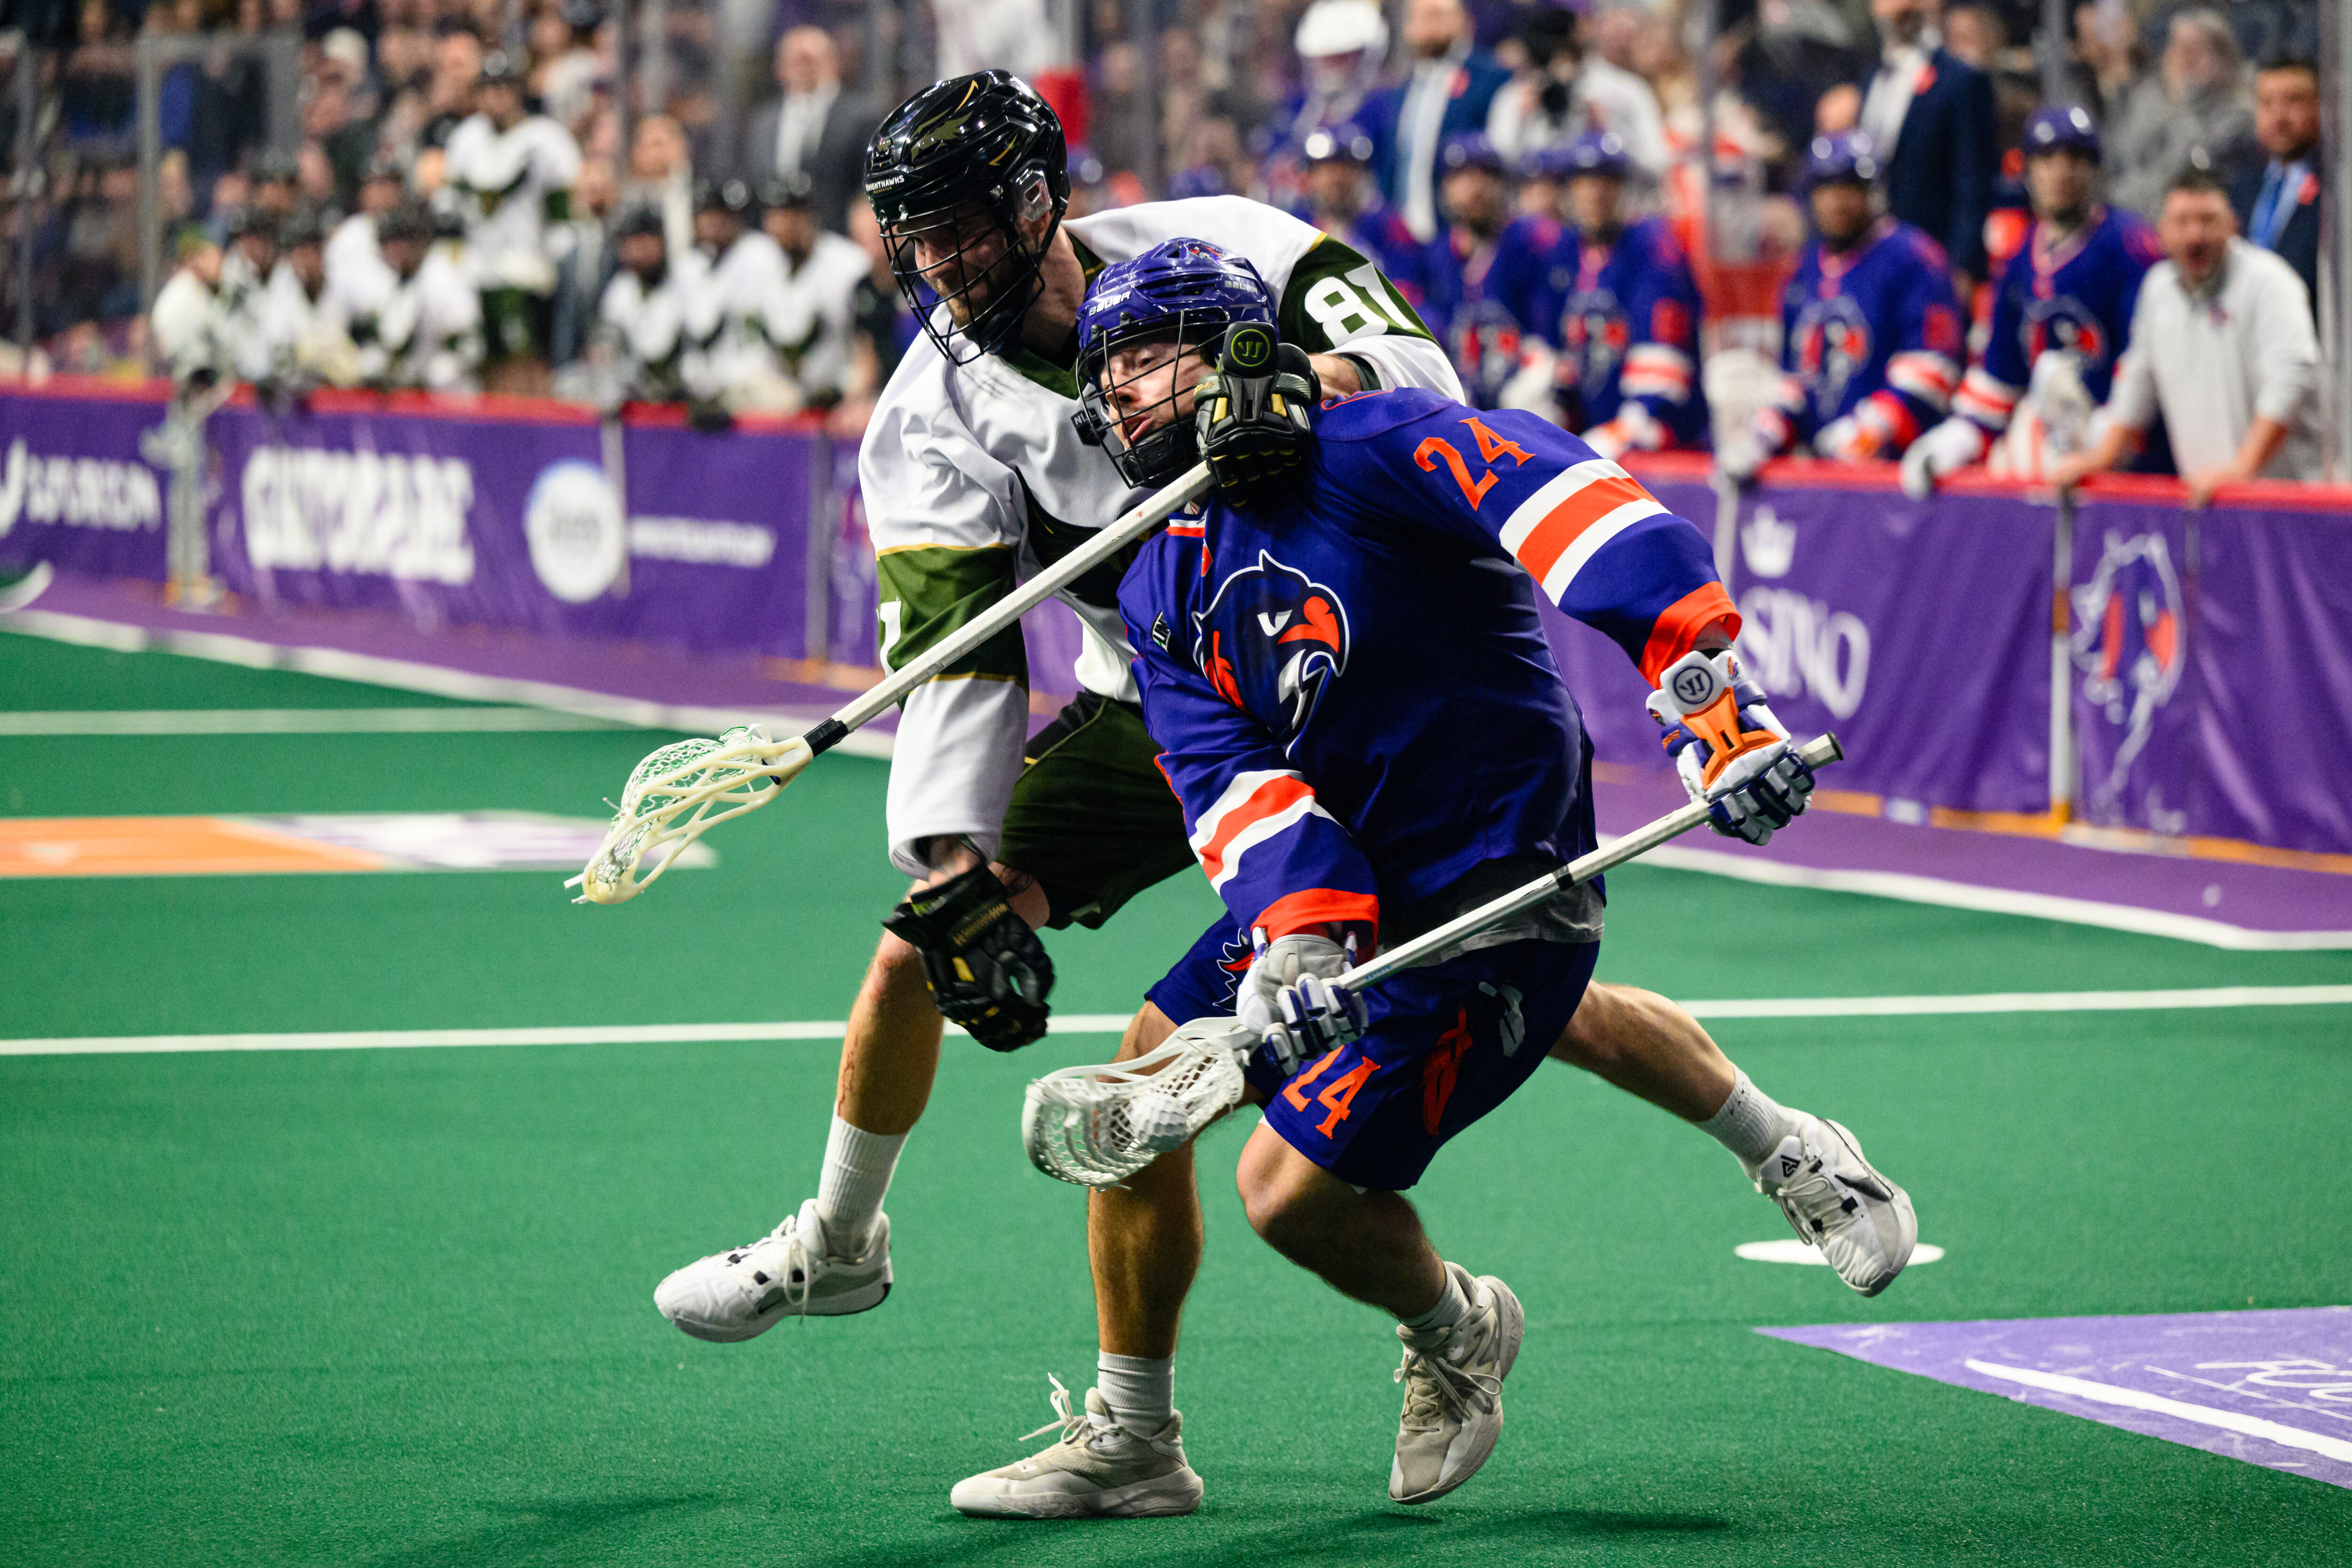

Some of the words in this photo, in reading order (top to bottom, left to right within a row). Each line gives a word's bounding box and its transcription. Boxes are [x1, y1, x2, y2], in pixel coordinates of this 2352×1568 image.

[866, 175, 905, 192] KNIGHTHAWKS
[1089, 291, 1131, 317] BAUER
[1414, 416, 1536, 512] 24
[1281, 1044, 1381, 1140] 24
